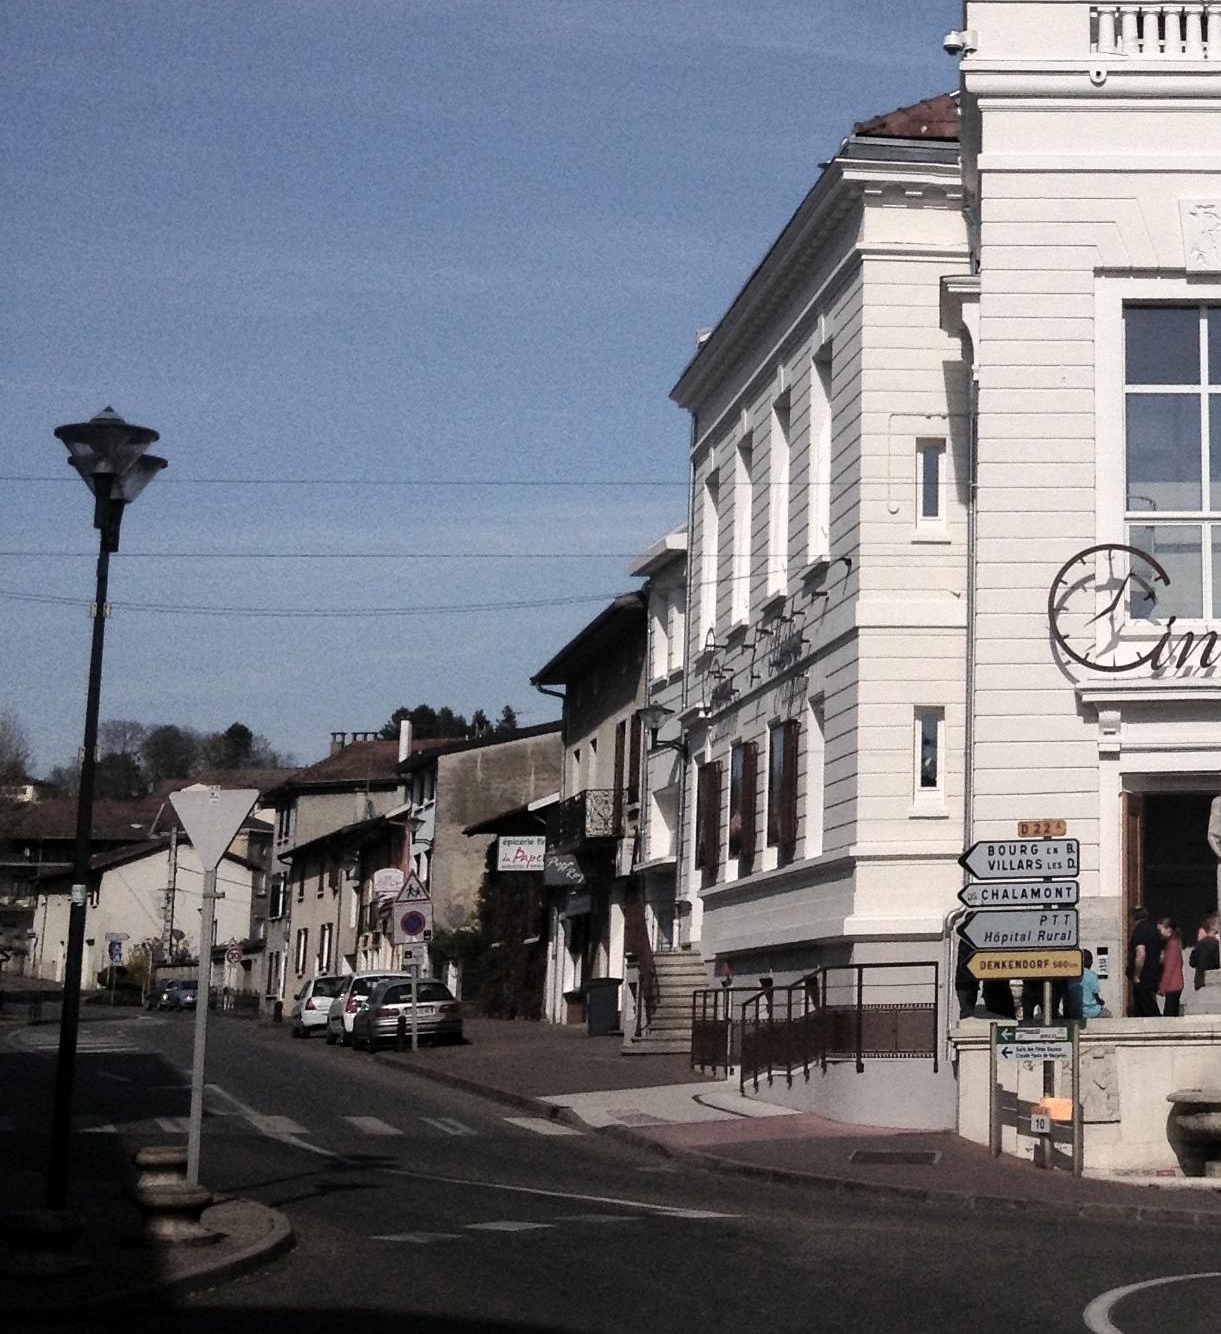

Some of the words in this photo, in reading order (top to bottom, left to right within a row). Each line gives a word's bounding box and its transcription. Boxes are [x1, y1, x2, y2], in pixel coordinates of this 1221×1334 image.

[1021, 824, 1028, 835] D
[988, 844, 1039, 856] BOURG
[988, 859, 1043, 871] VILLARS
[981, 887, 1072, 900] CHALAMONT
[984, 930, 1032, 945] Hôpital
[1038, 930, 1072, 941] Rural
[980, 959, 1049, 971] DENKENDORF
[1035, 1118, 1045, 1129] 10
